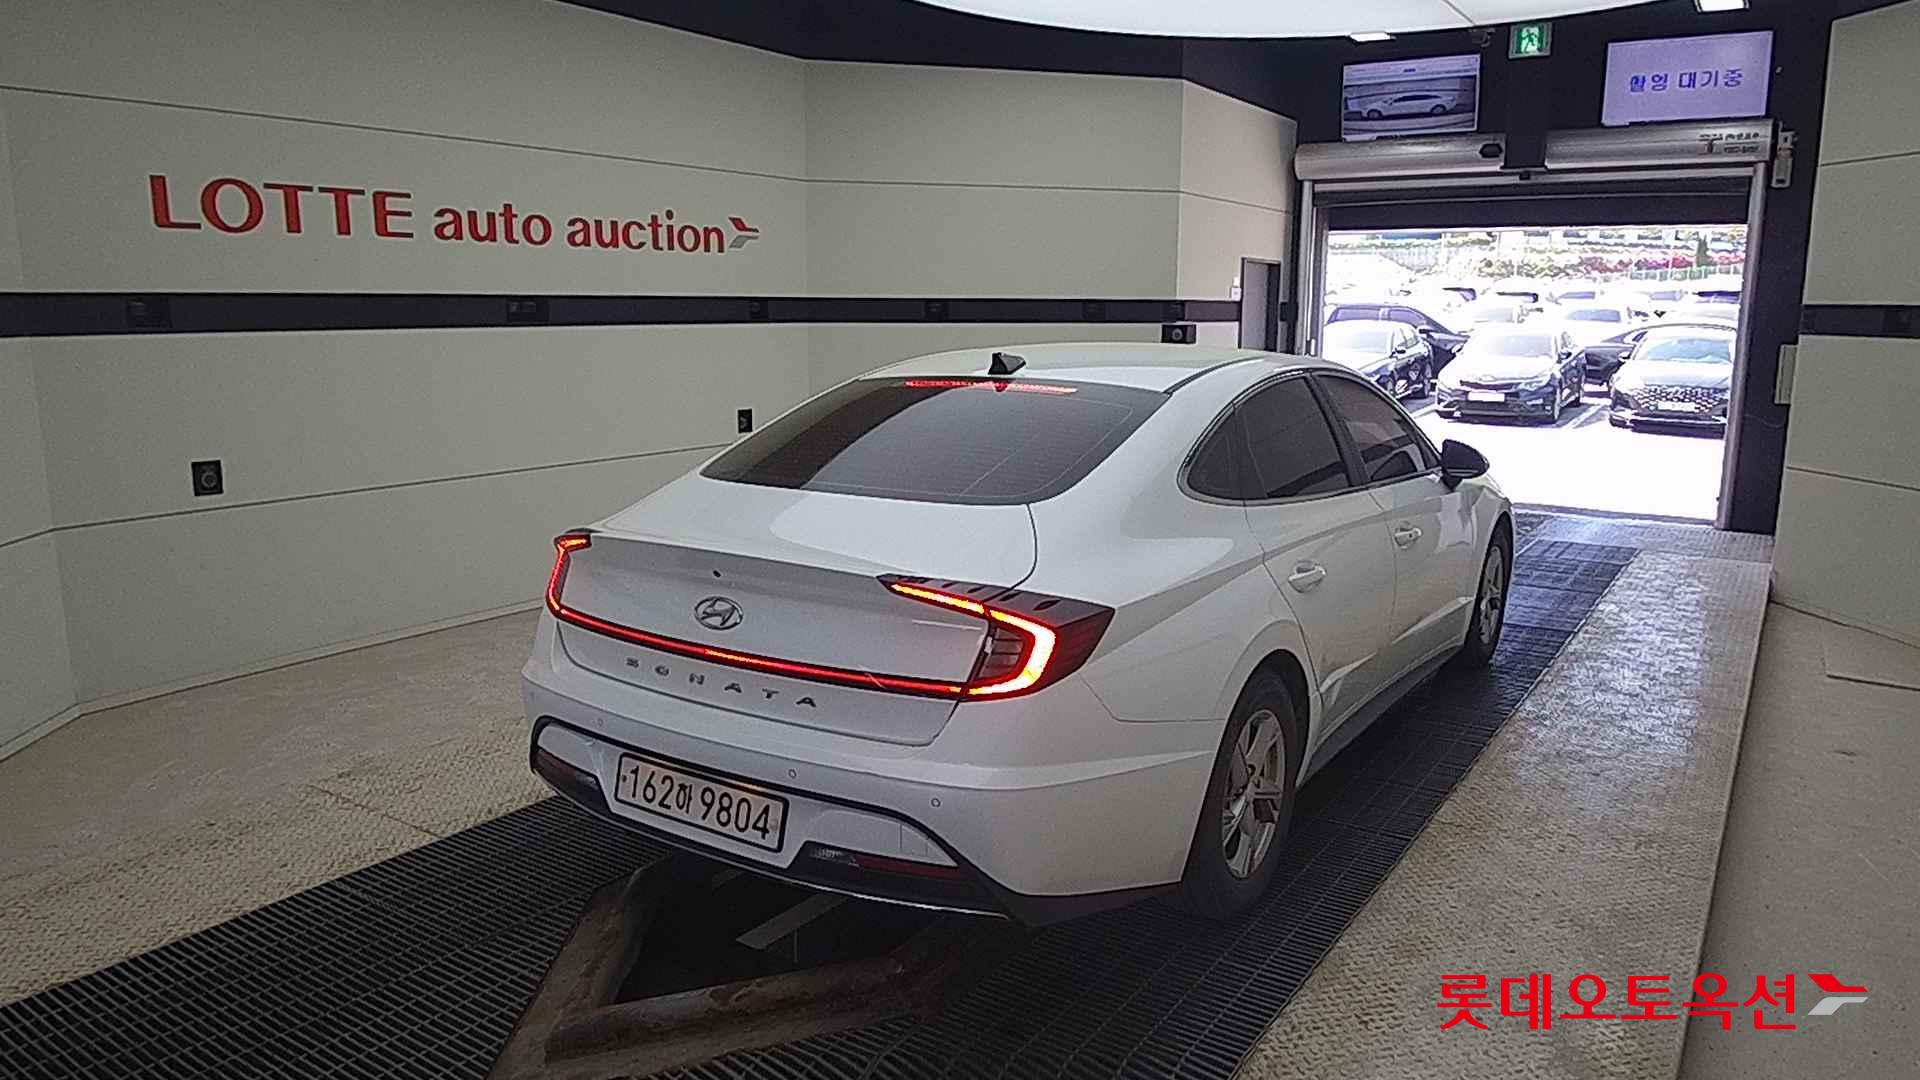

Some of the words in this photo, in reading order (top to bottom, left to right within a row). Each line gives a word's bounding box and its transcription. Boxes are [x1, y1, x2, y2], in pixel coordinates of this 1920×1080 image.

[150, 174, 414, 239] LOTTE
[433, 203, 552, 246] auto
[566, 208, 725, 254] auction
[626, 656, 817, 708] SONATA
